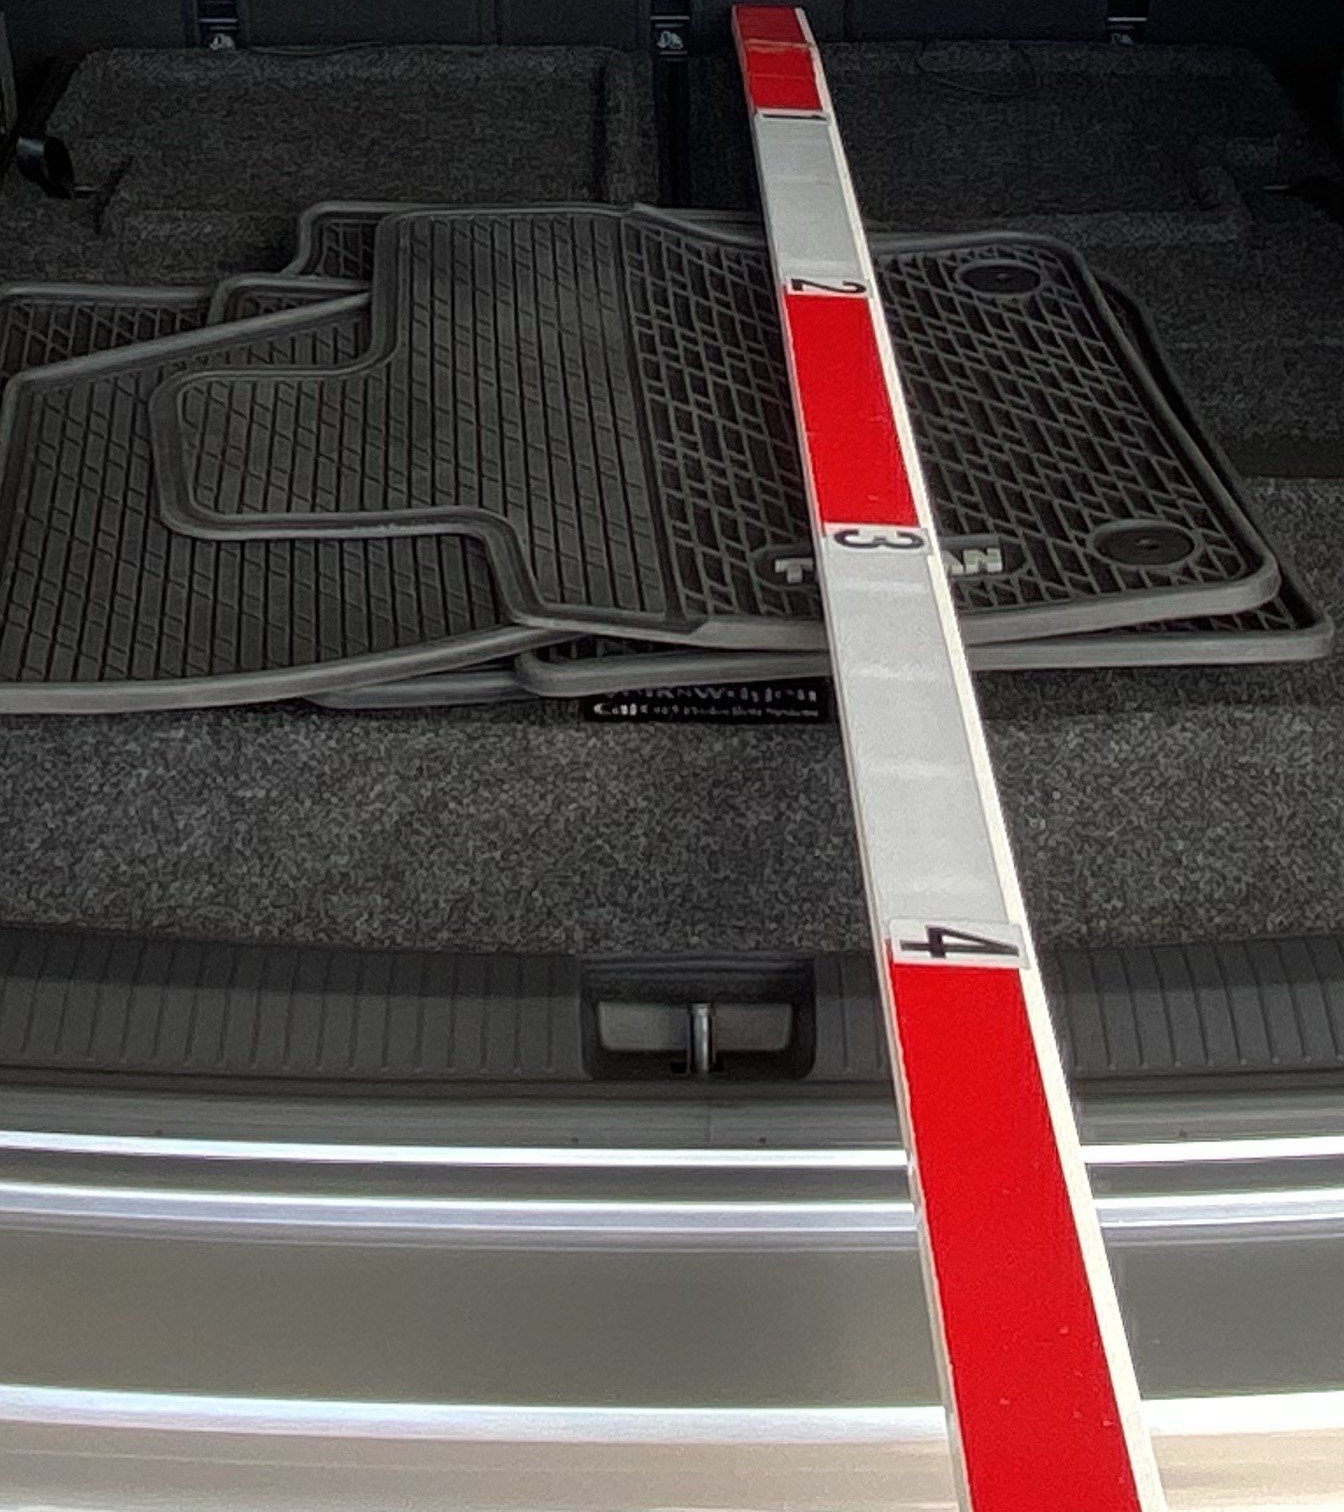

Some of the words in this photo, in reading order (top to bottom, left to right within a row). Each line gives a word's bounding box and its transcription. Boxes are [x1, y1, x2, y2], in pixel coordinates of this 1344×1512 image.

[790, 278, 867, 294] 2
[832, 528, 924, 550] 3
[899, 925, 1020, 959] 4
